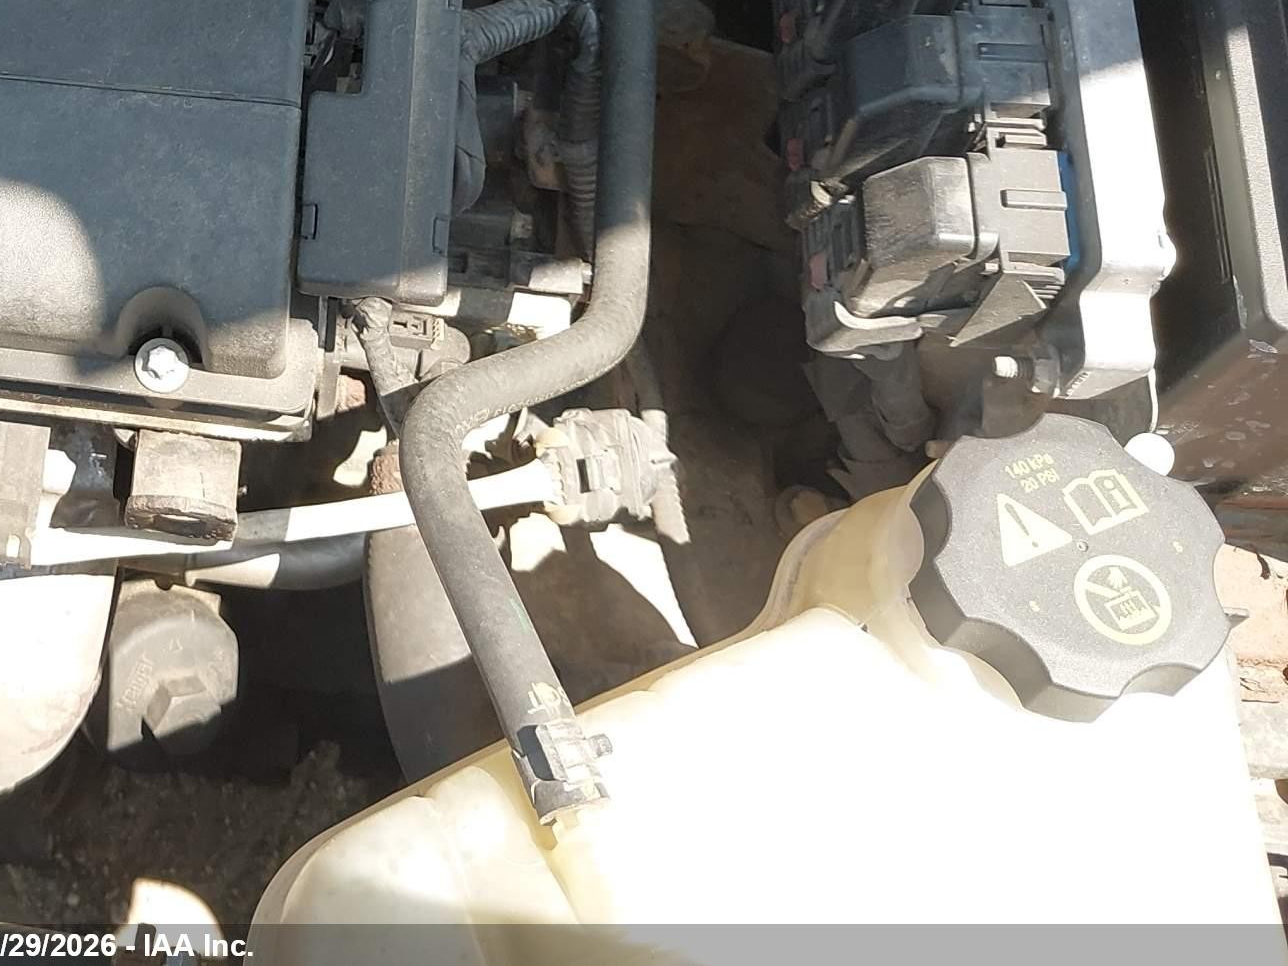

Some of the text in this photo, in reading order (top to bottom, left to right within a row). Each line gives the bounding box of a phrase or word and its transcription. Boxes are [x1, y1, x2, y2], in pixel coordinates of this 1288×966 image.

[1004, 460, 1031, 479] 140
[1020, 467, 1061, 493] 20 PSI
